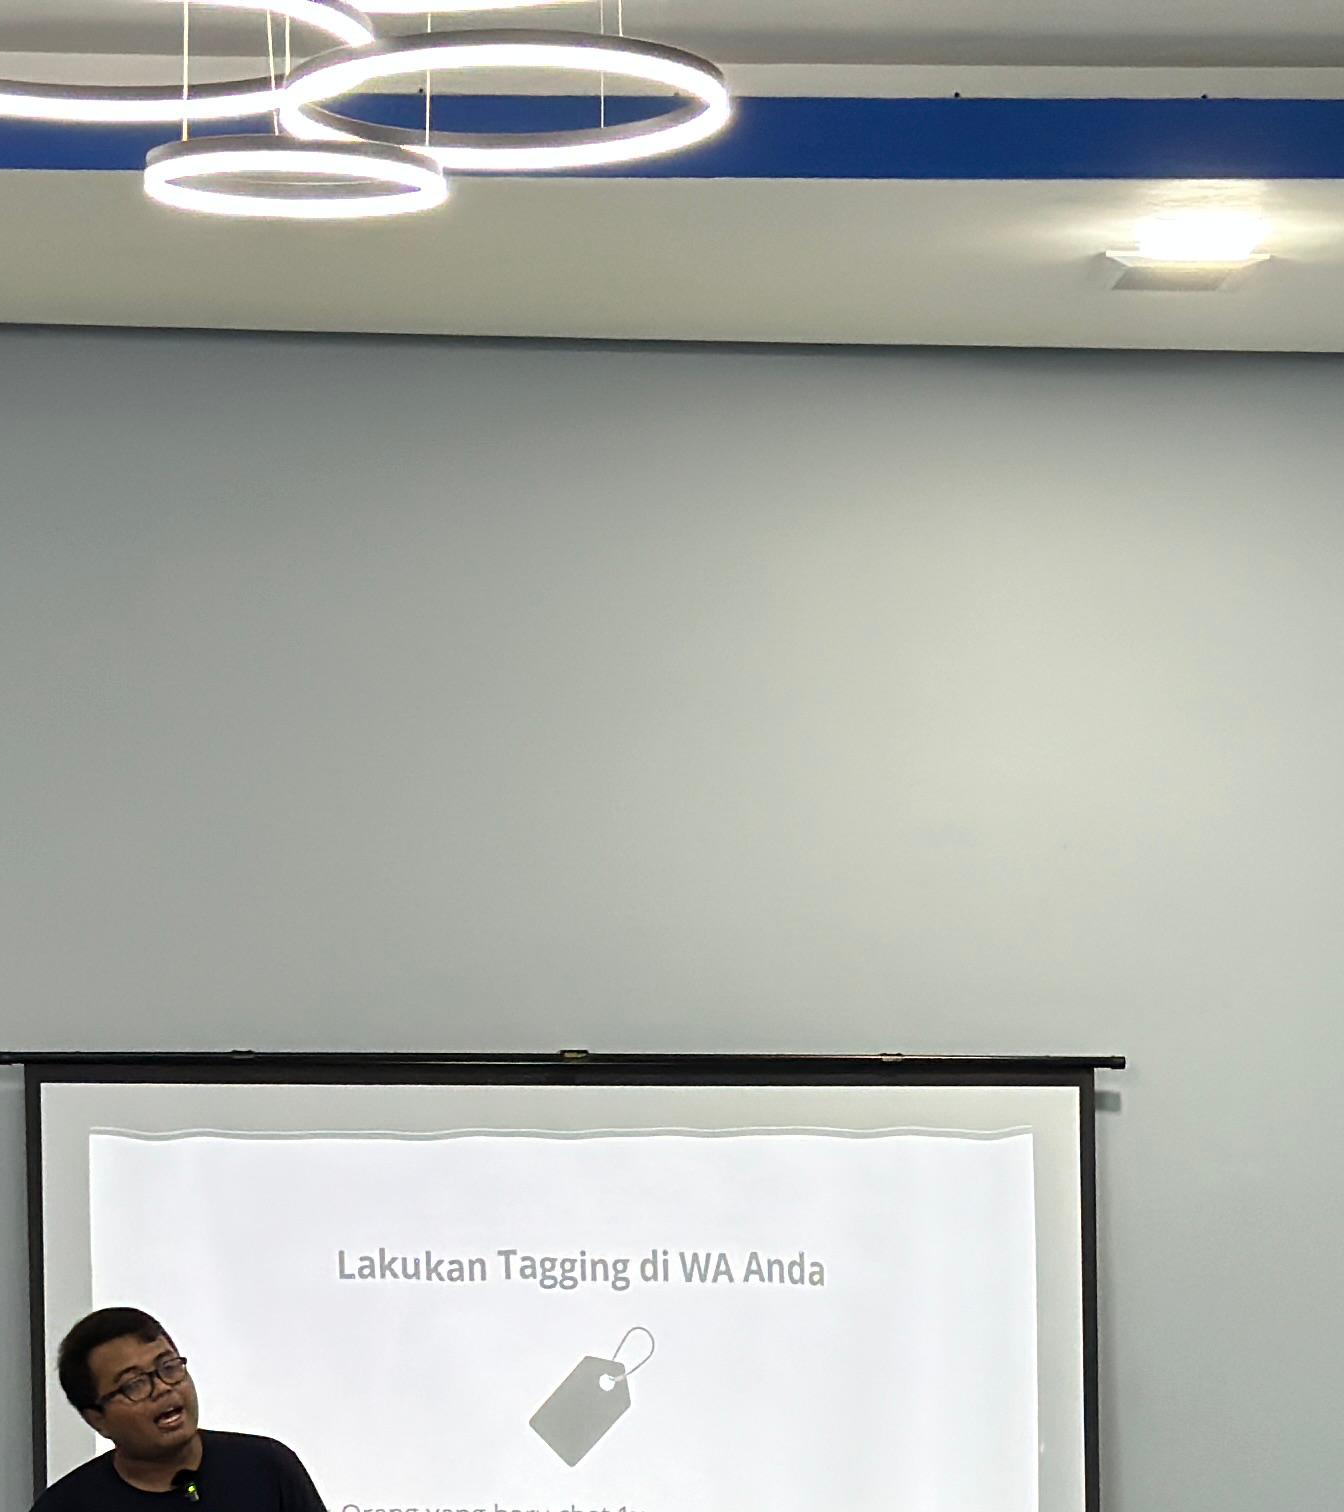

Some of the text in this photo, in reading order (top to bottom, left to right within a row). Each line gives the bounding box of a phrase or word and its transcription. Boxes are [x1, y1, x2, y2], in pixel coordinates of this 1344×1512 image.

[338, 1248, 825, 1291] Lakukan Tagging di WA Anda
